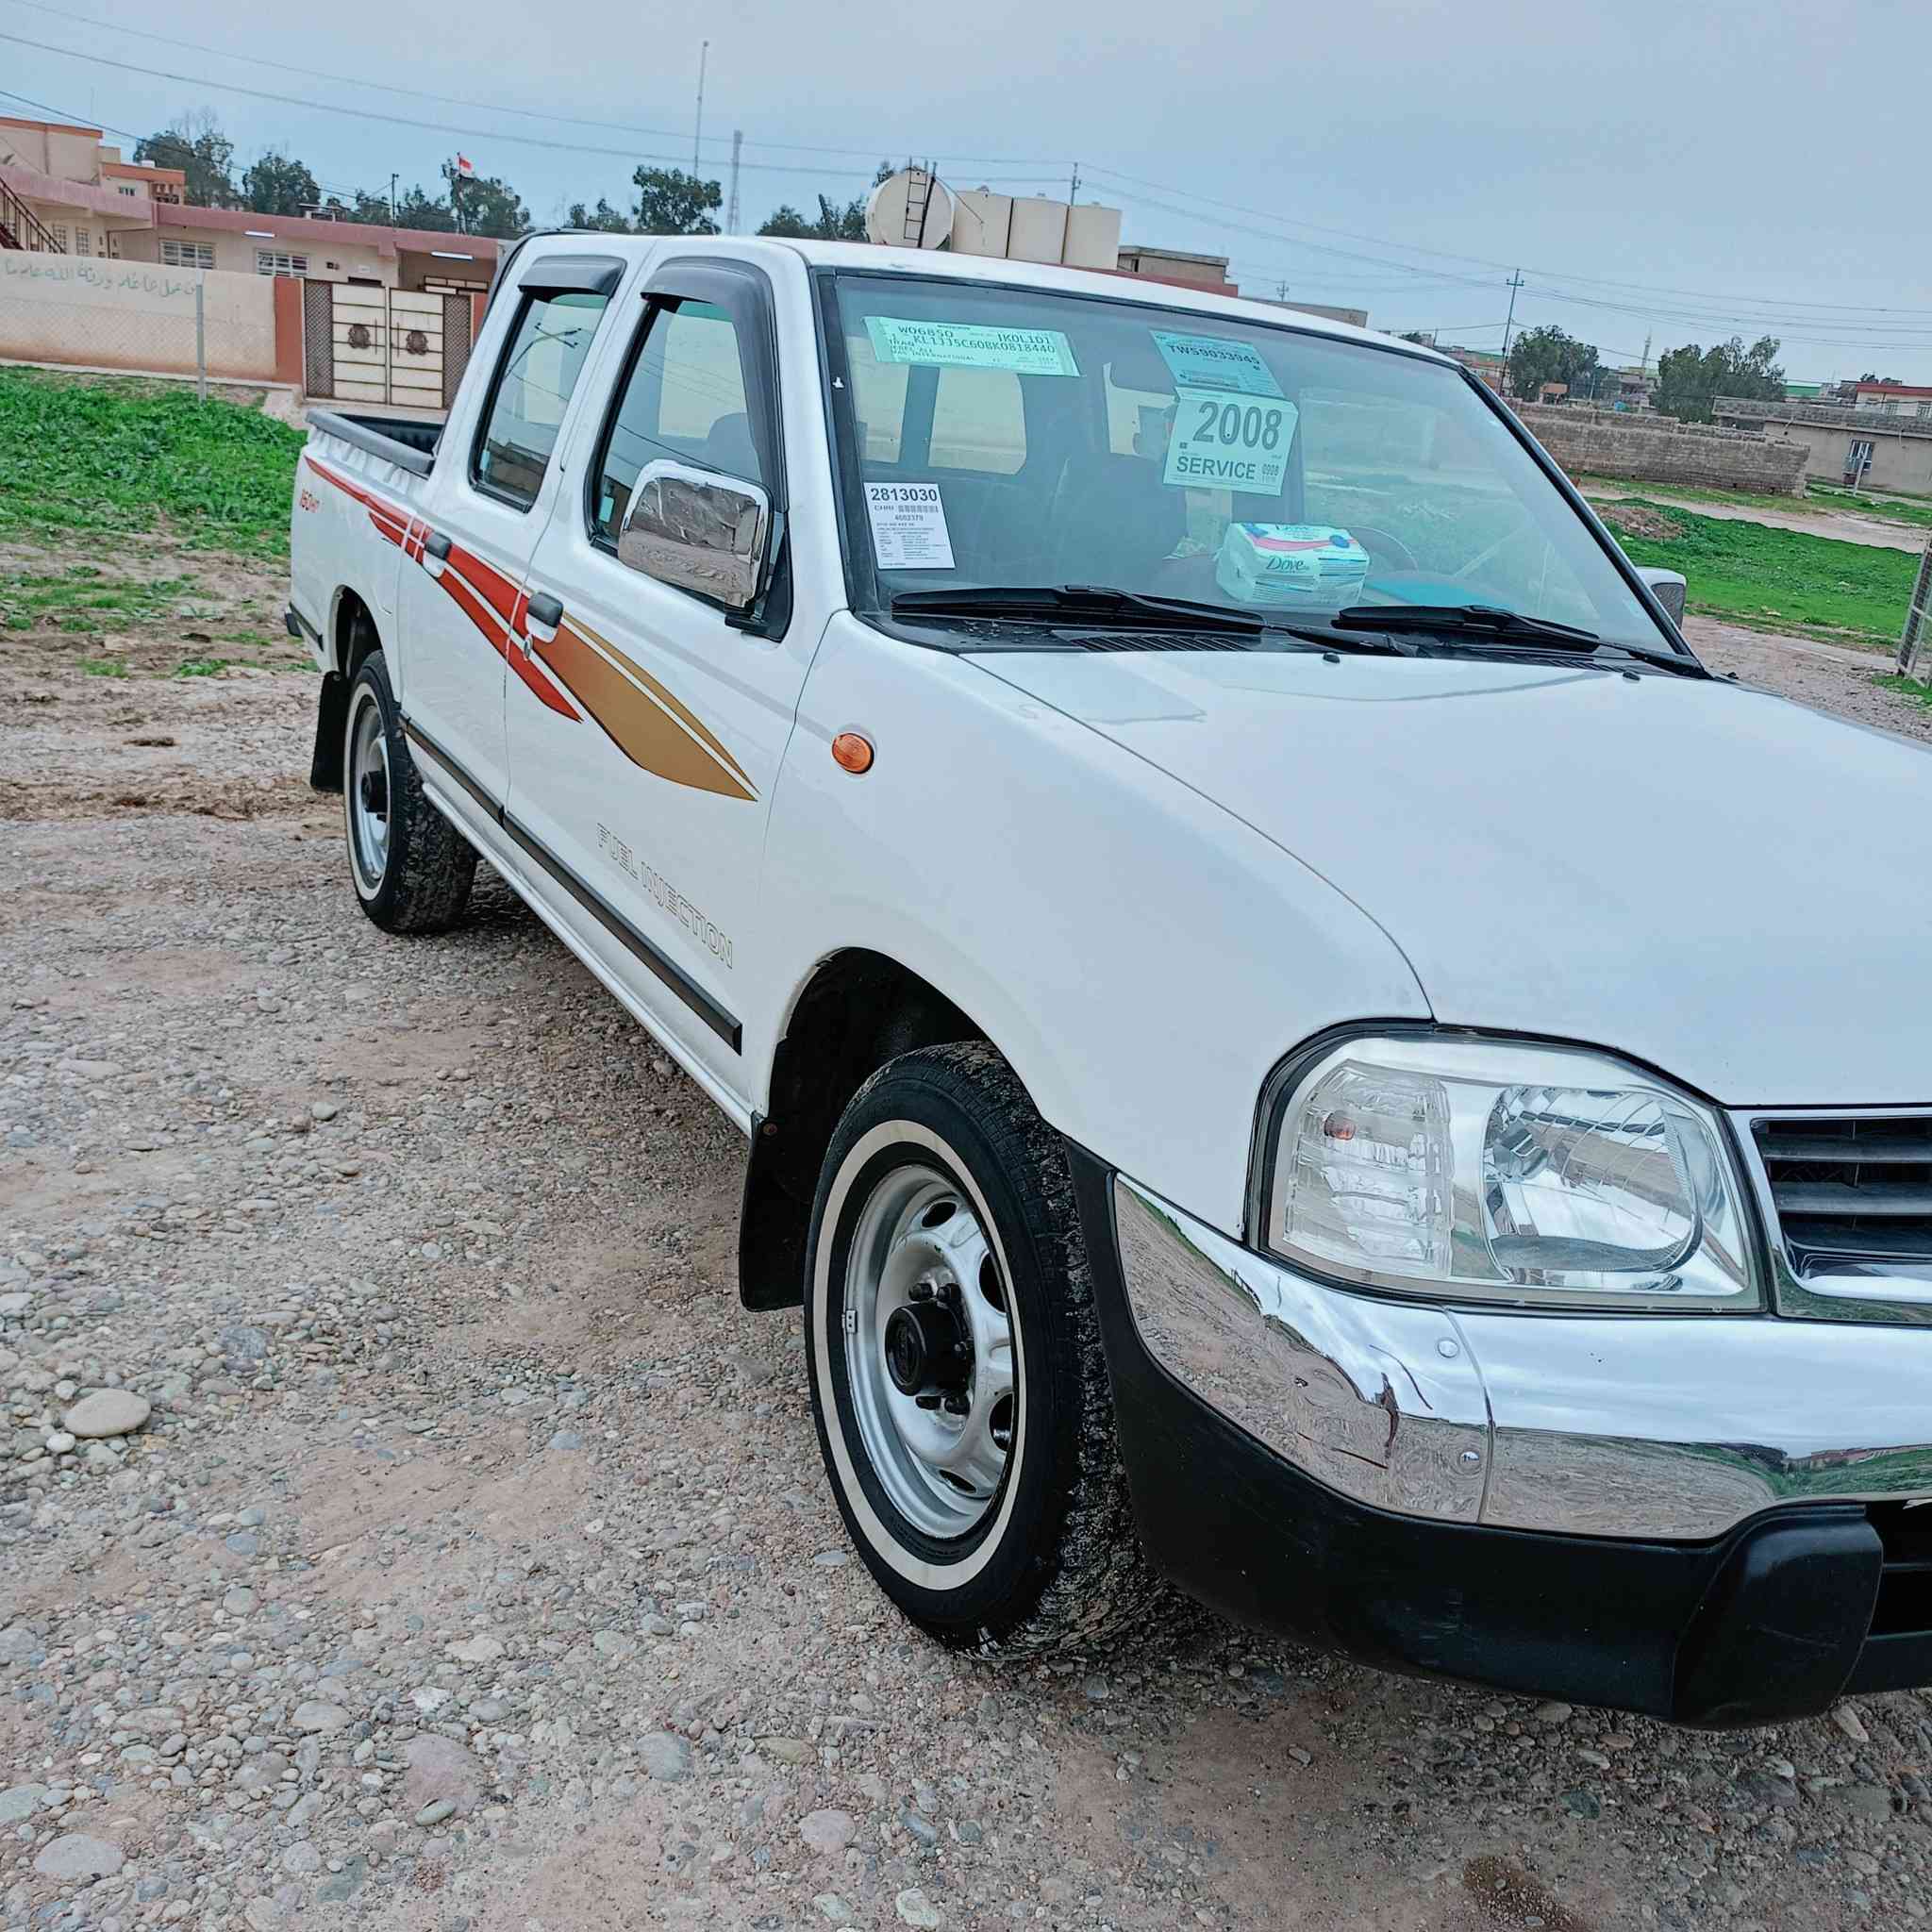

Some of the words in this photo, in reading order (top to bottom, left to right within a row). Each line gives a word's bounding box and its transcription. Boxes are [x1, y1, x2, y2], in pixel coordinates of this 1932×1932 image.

[1192, 401, 1282, 450] 2008
[1177, 456, 1256, 480] SERVICE
[871, 488, 938, 501] 2813030
[1266, 555, 1306, 570] Dove
[596, 823, 639, 880] FUEL
[641, 860, 733, 970] INJECTION
